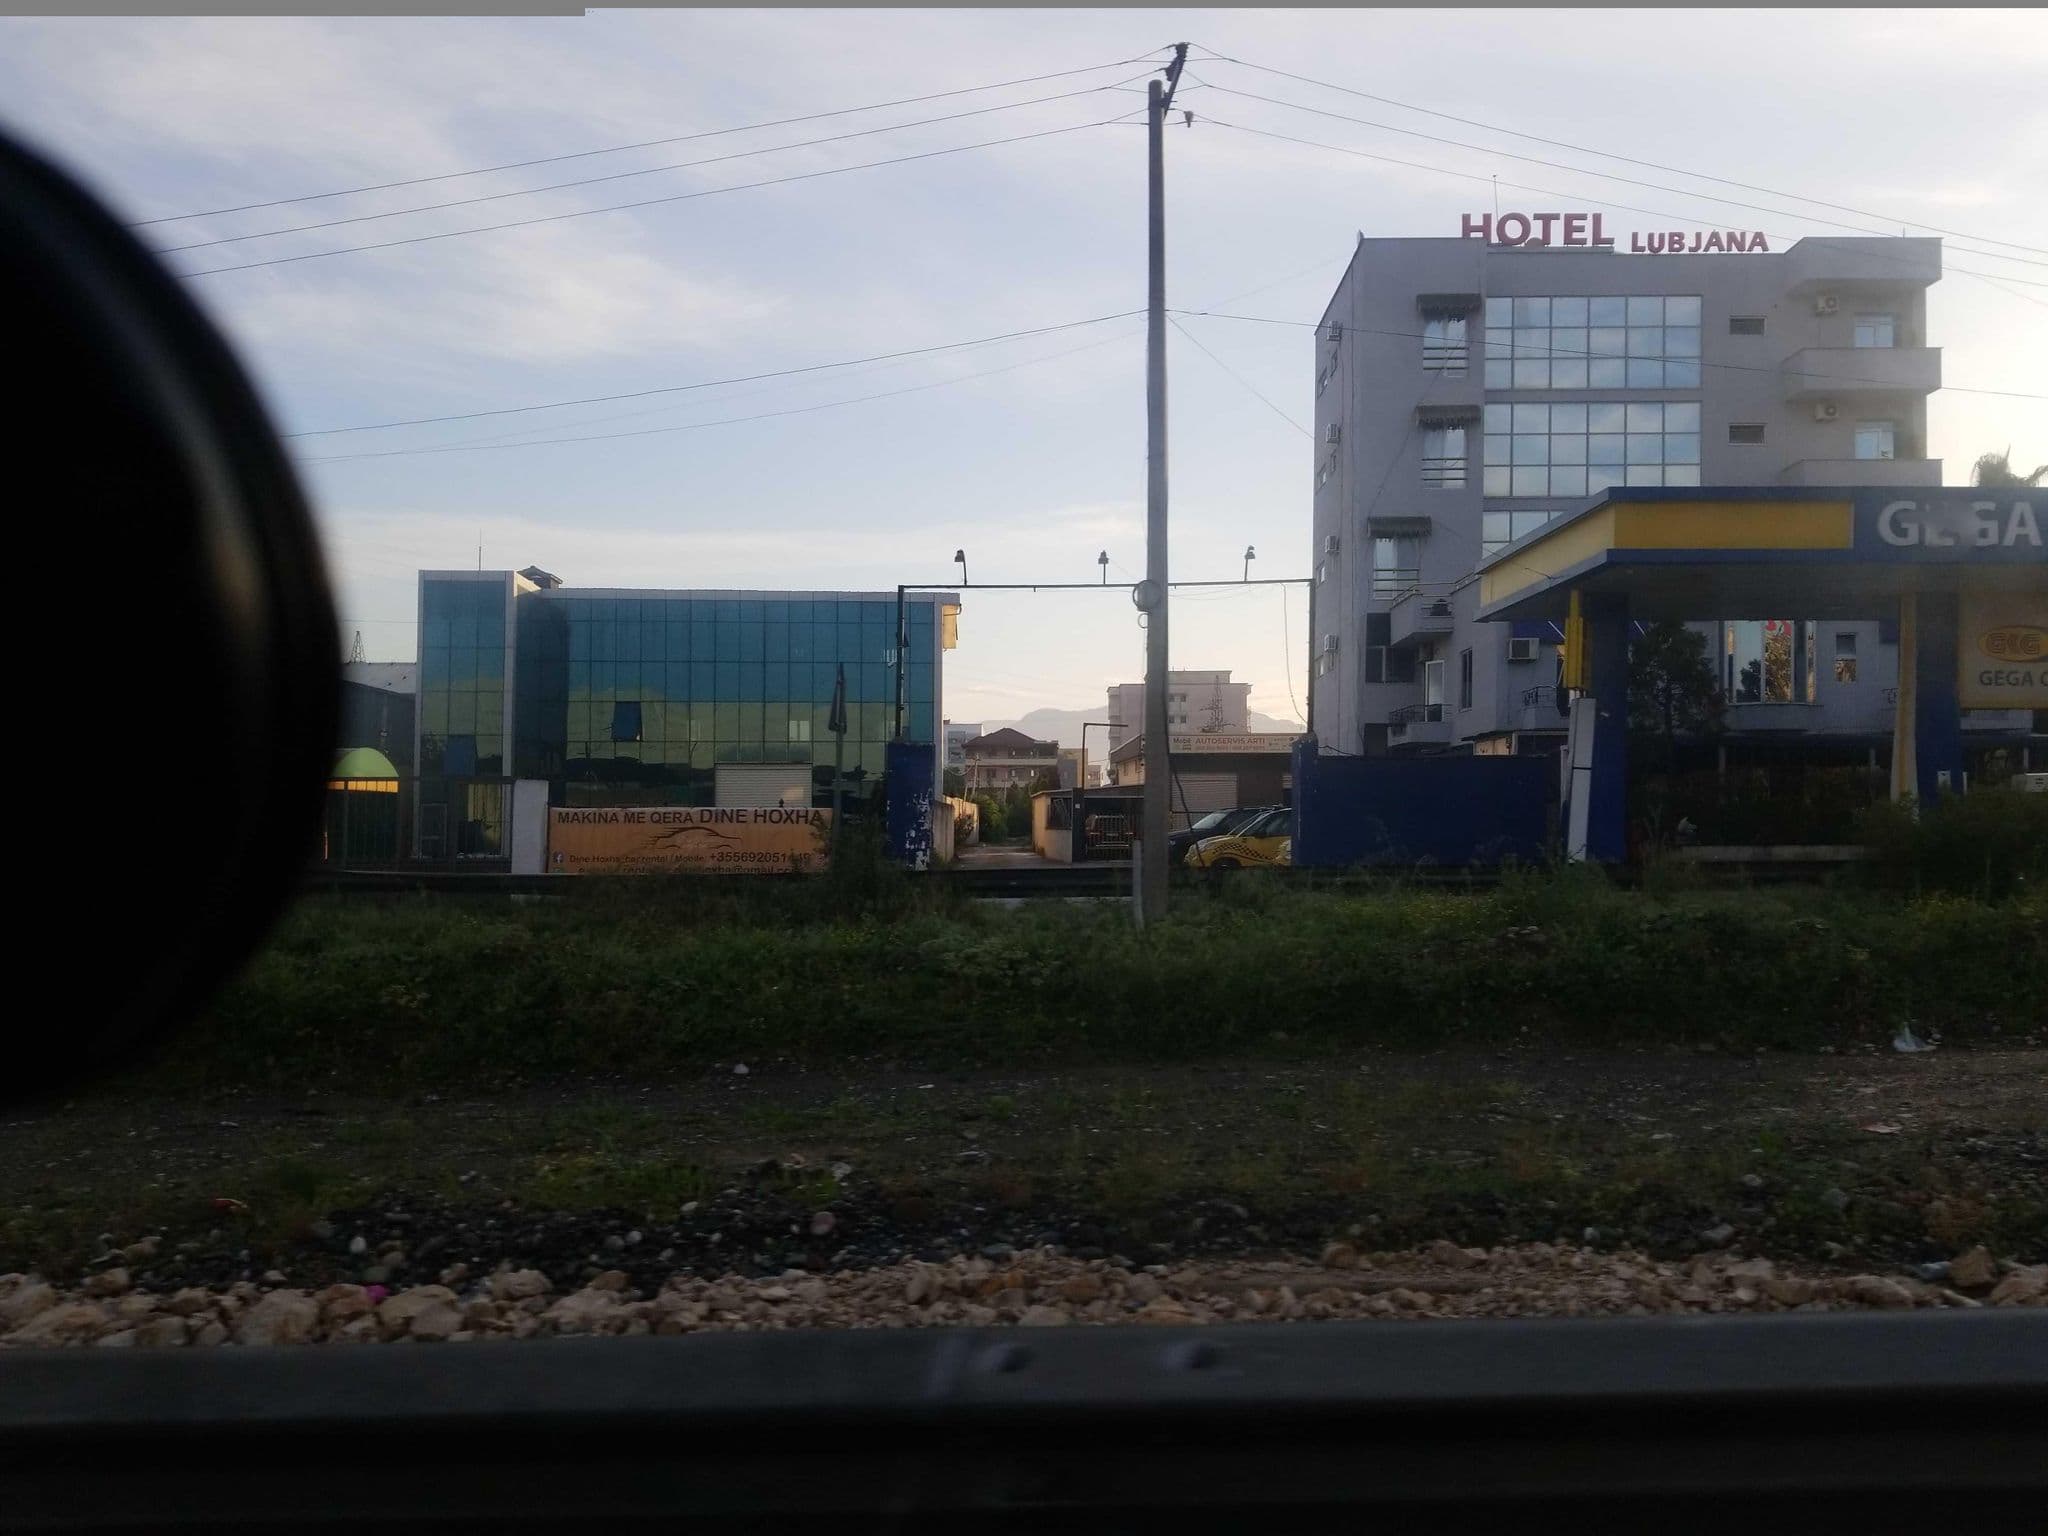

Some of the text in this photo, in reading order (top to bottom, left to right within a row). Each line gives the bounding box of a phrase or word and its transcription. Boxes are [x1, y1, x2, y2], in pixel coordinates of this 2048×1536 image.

[1461, 212, 1769, 253] HOTEL LUBJANA
[1979, 671, 2033, 687] GEGA
[557, 809, 823, 825] MAKINA ME QERA DINE HOXHA
